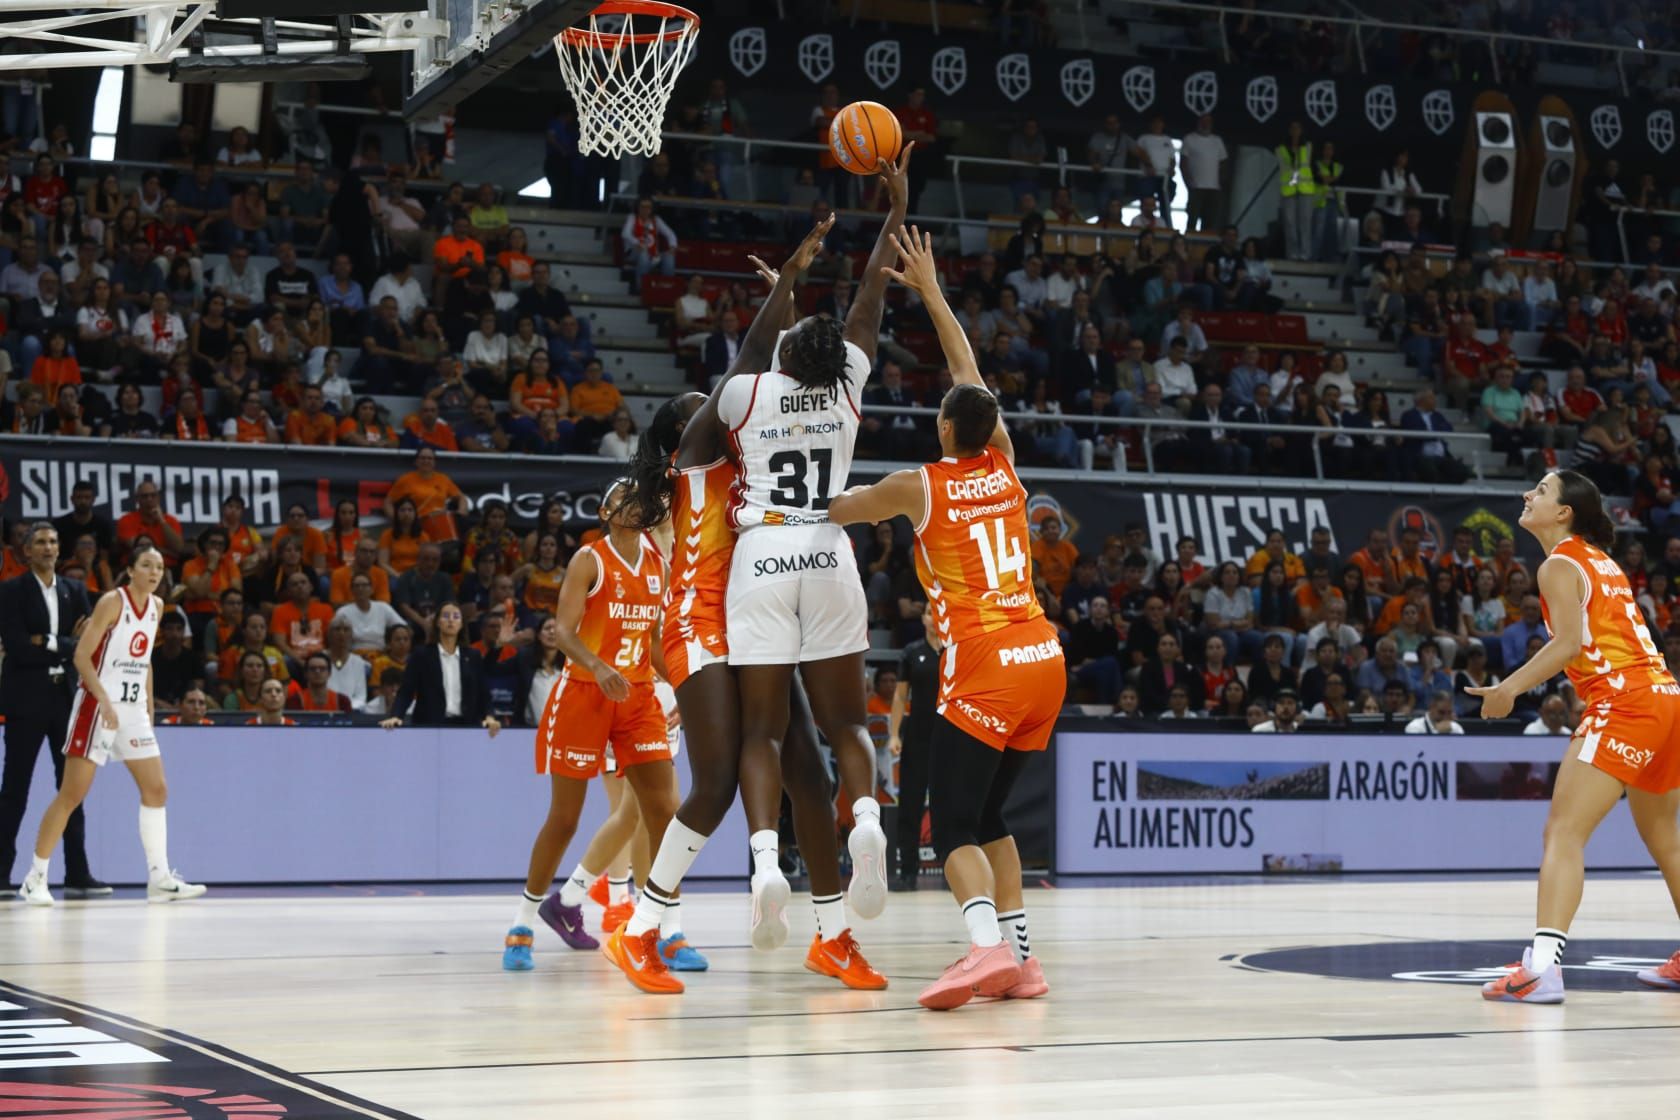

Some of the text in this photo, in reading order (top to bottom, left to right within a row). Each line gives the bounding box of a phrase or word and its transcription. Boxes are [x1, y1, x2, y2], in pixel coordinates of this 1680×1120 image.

[781, 393, 828, 414] GUEYE
[760, 422, 844, 440] AIR HORIZONT
[768, 448, 833, 510] 31
[946, 468, 1012, 500] CARRERA
[1143, 492, 1340, 568] HUESCA
[754, 551, 839, 577] SOMMOS
[969, 517, 1026, 590] 14
[608, 602, 661, 620] VALENCI
[622, 621, 650, 632] BASKET
[998, 639, 1062, 667] PAMESA
[120, 681, 140, 703] 13
[1607, 738, 1644, 764] MGS
[1092, 751, 1449, 801] EN ARAGÓN
[1094, 807, 1254, 849] ALIMENTOS
